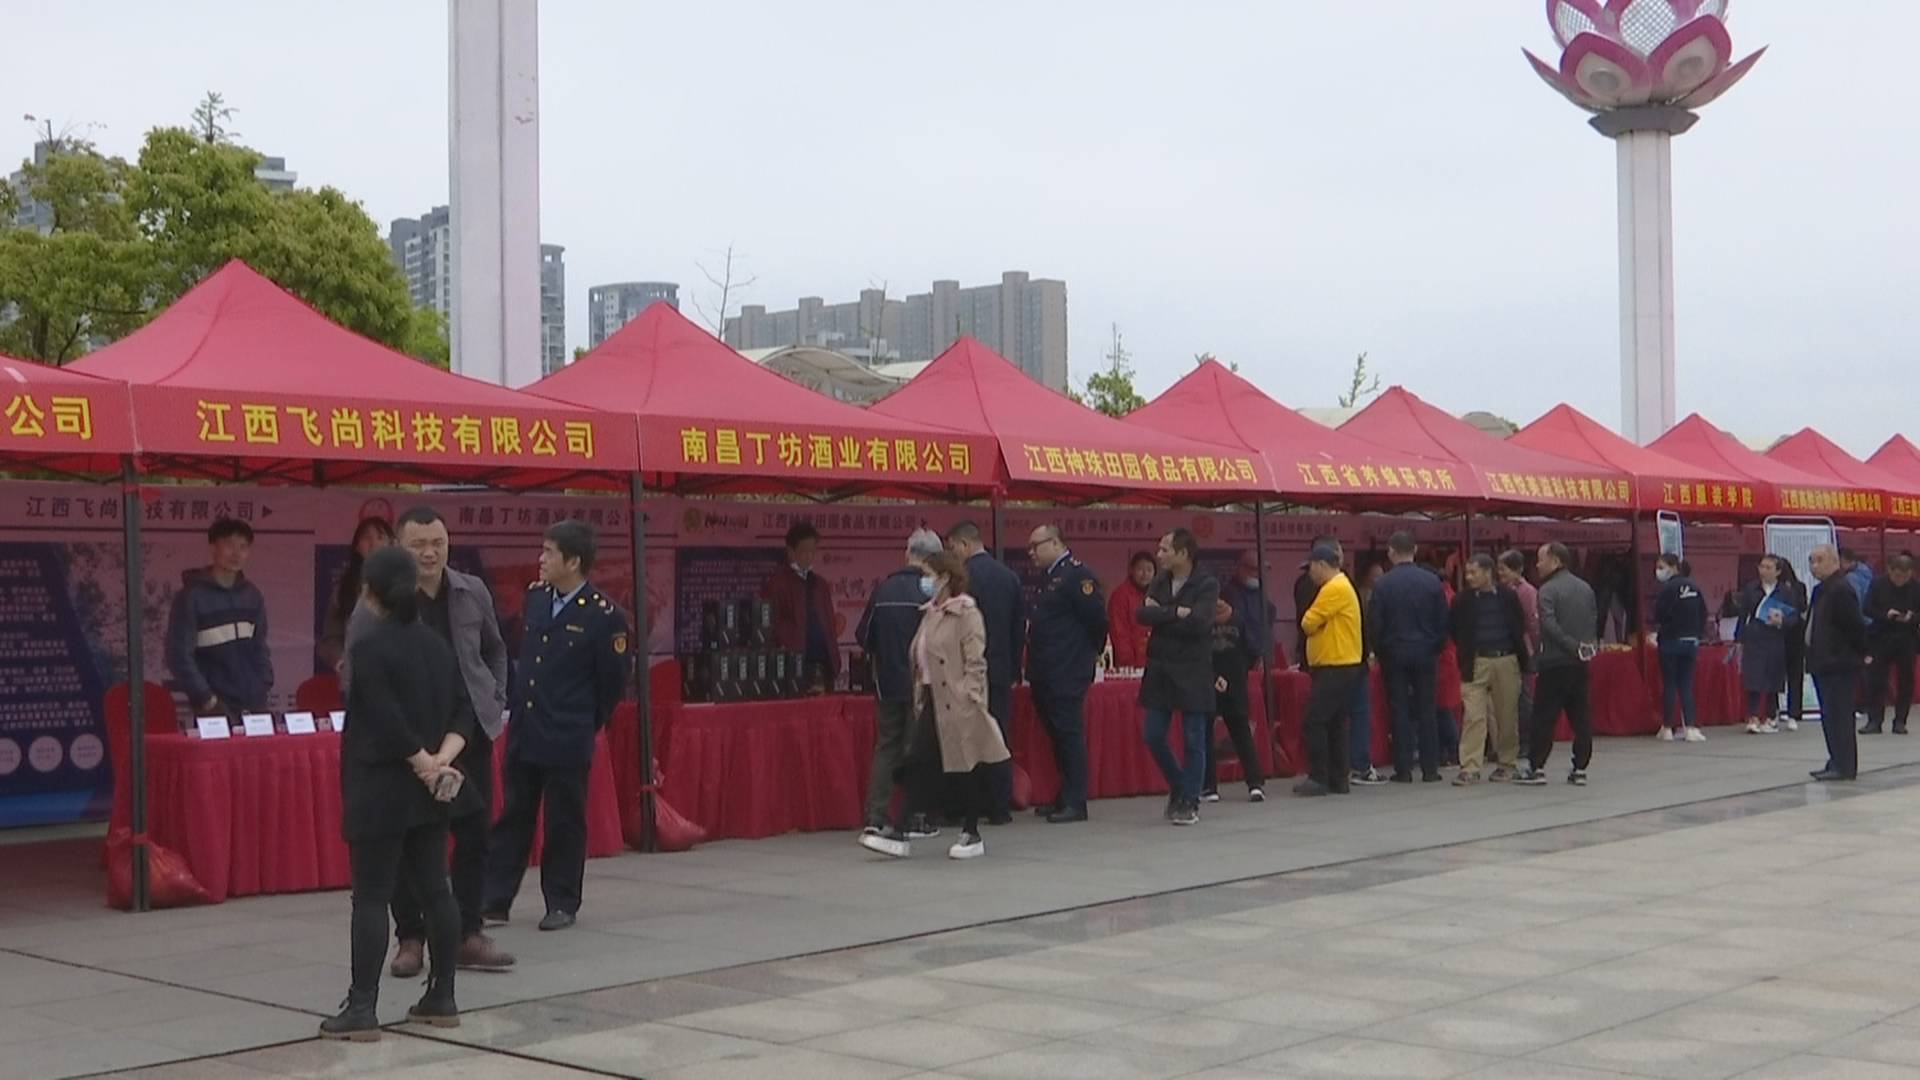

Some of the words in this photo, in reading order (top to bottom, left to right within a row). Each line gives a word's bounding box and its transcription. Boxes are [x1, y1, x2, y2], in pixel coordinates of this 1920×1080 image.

[5, 395, 92, 440] 公司
[195, 399, 595, 459] 江西飞尚科技有限公司
[680, 426, 972, 476] 南昌丁坊酒业有限公司
[1023, 443, 1258, 486] 江西神珠田园食品有限公司
[1297, 462, 1456, 491] 江西省养蜂研究所
[26, 495, 255, 521] 江西飞尚技有限公司
